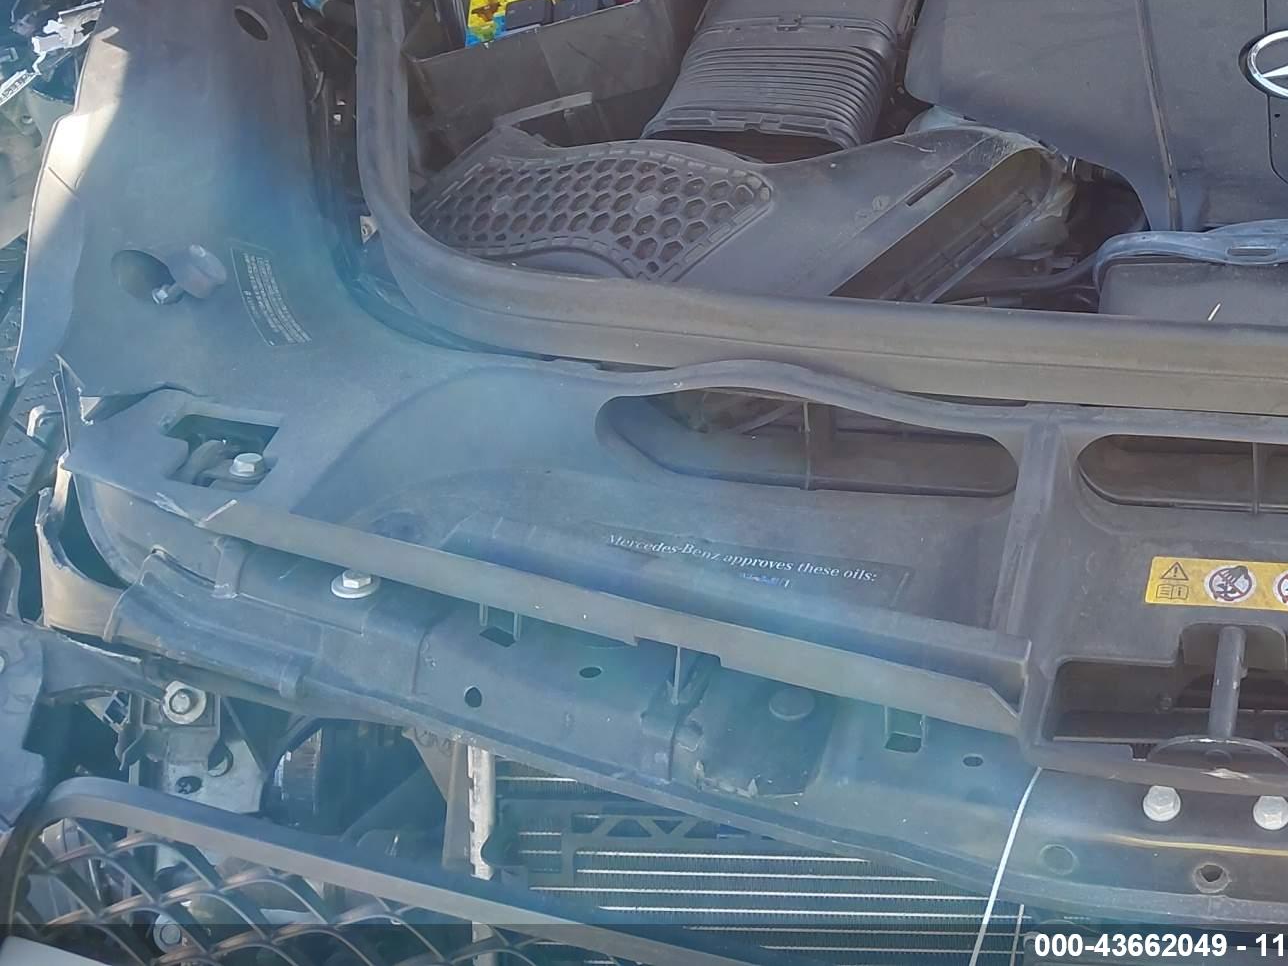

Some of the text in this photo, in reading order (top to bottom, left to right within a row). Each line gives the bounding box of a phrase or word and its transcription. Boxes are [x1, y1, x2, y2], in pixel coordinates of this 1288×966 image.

[607, 534, 879, 583] Mercedes-Benz approves these oils:
